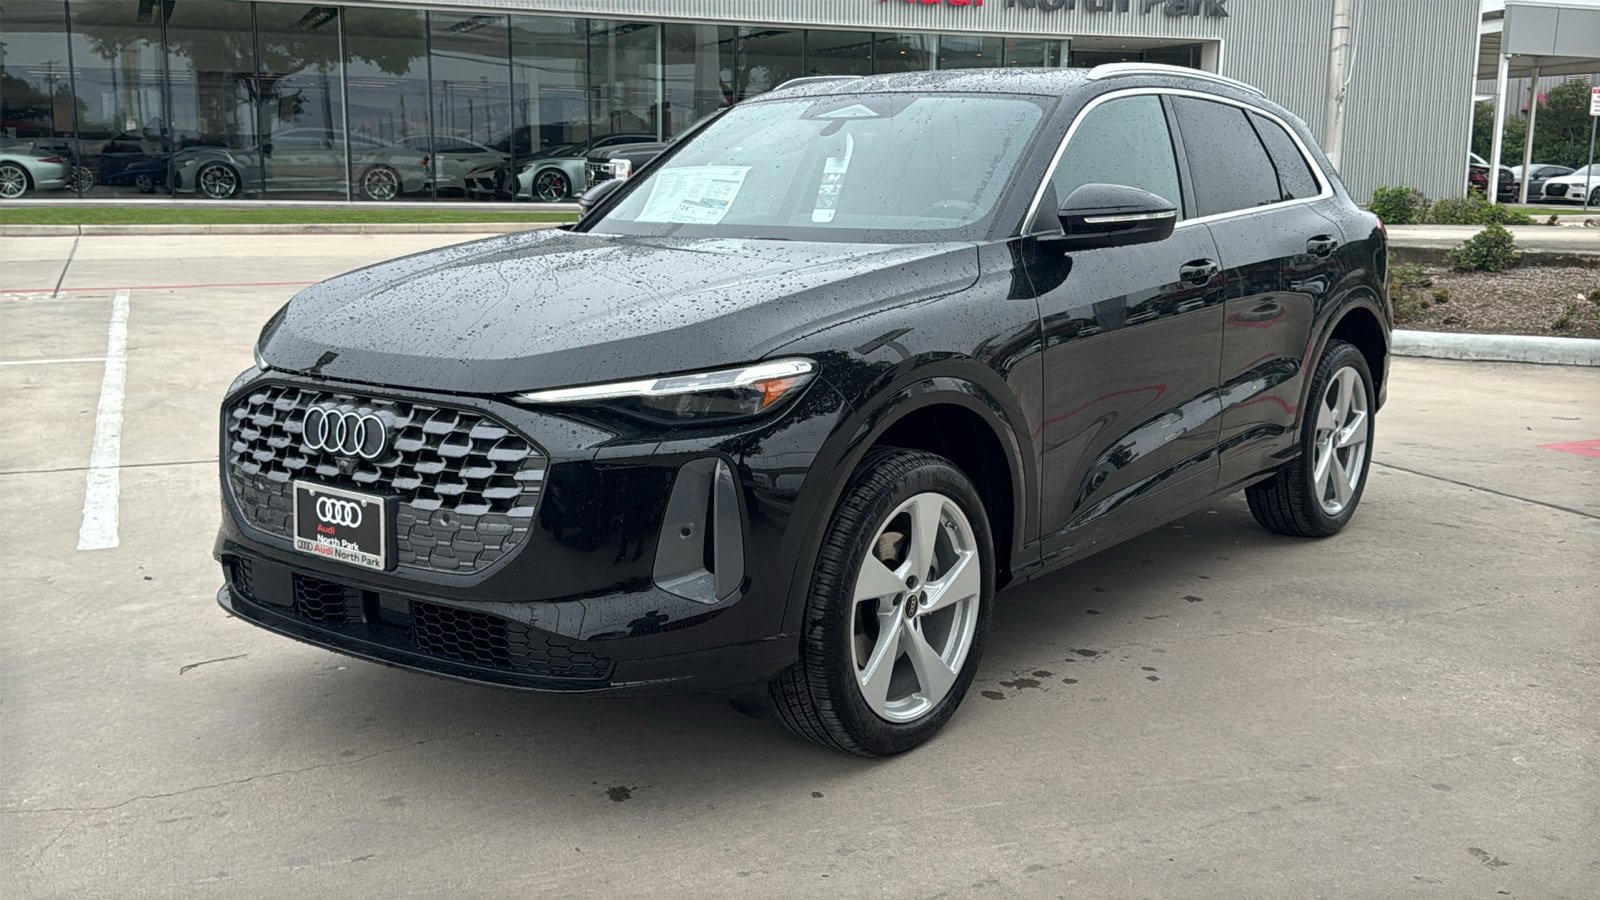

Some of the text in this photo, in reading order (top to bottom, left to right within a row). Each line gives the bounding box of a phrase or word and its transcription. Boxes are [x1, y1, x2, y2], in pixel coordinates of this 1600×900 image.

[1138, 0, 1230, 17] Park
[317, 524, 336, 535] Audi
[317, 534, 360, 551] North Park
[314, 543, 381, 568] Audi North Park
